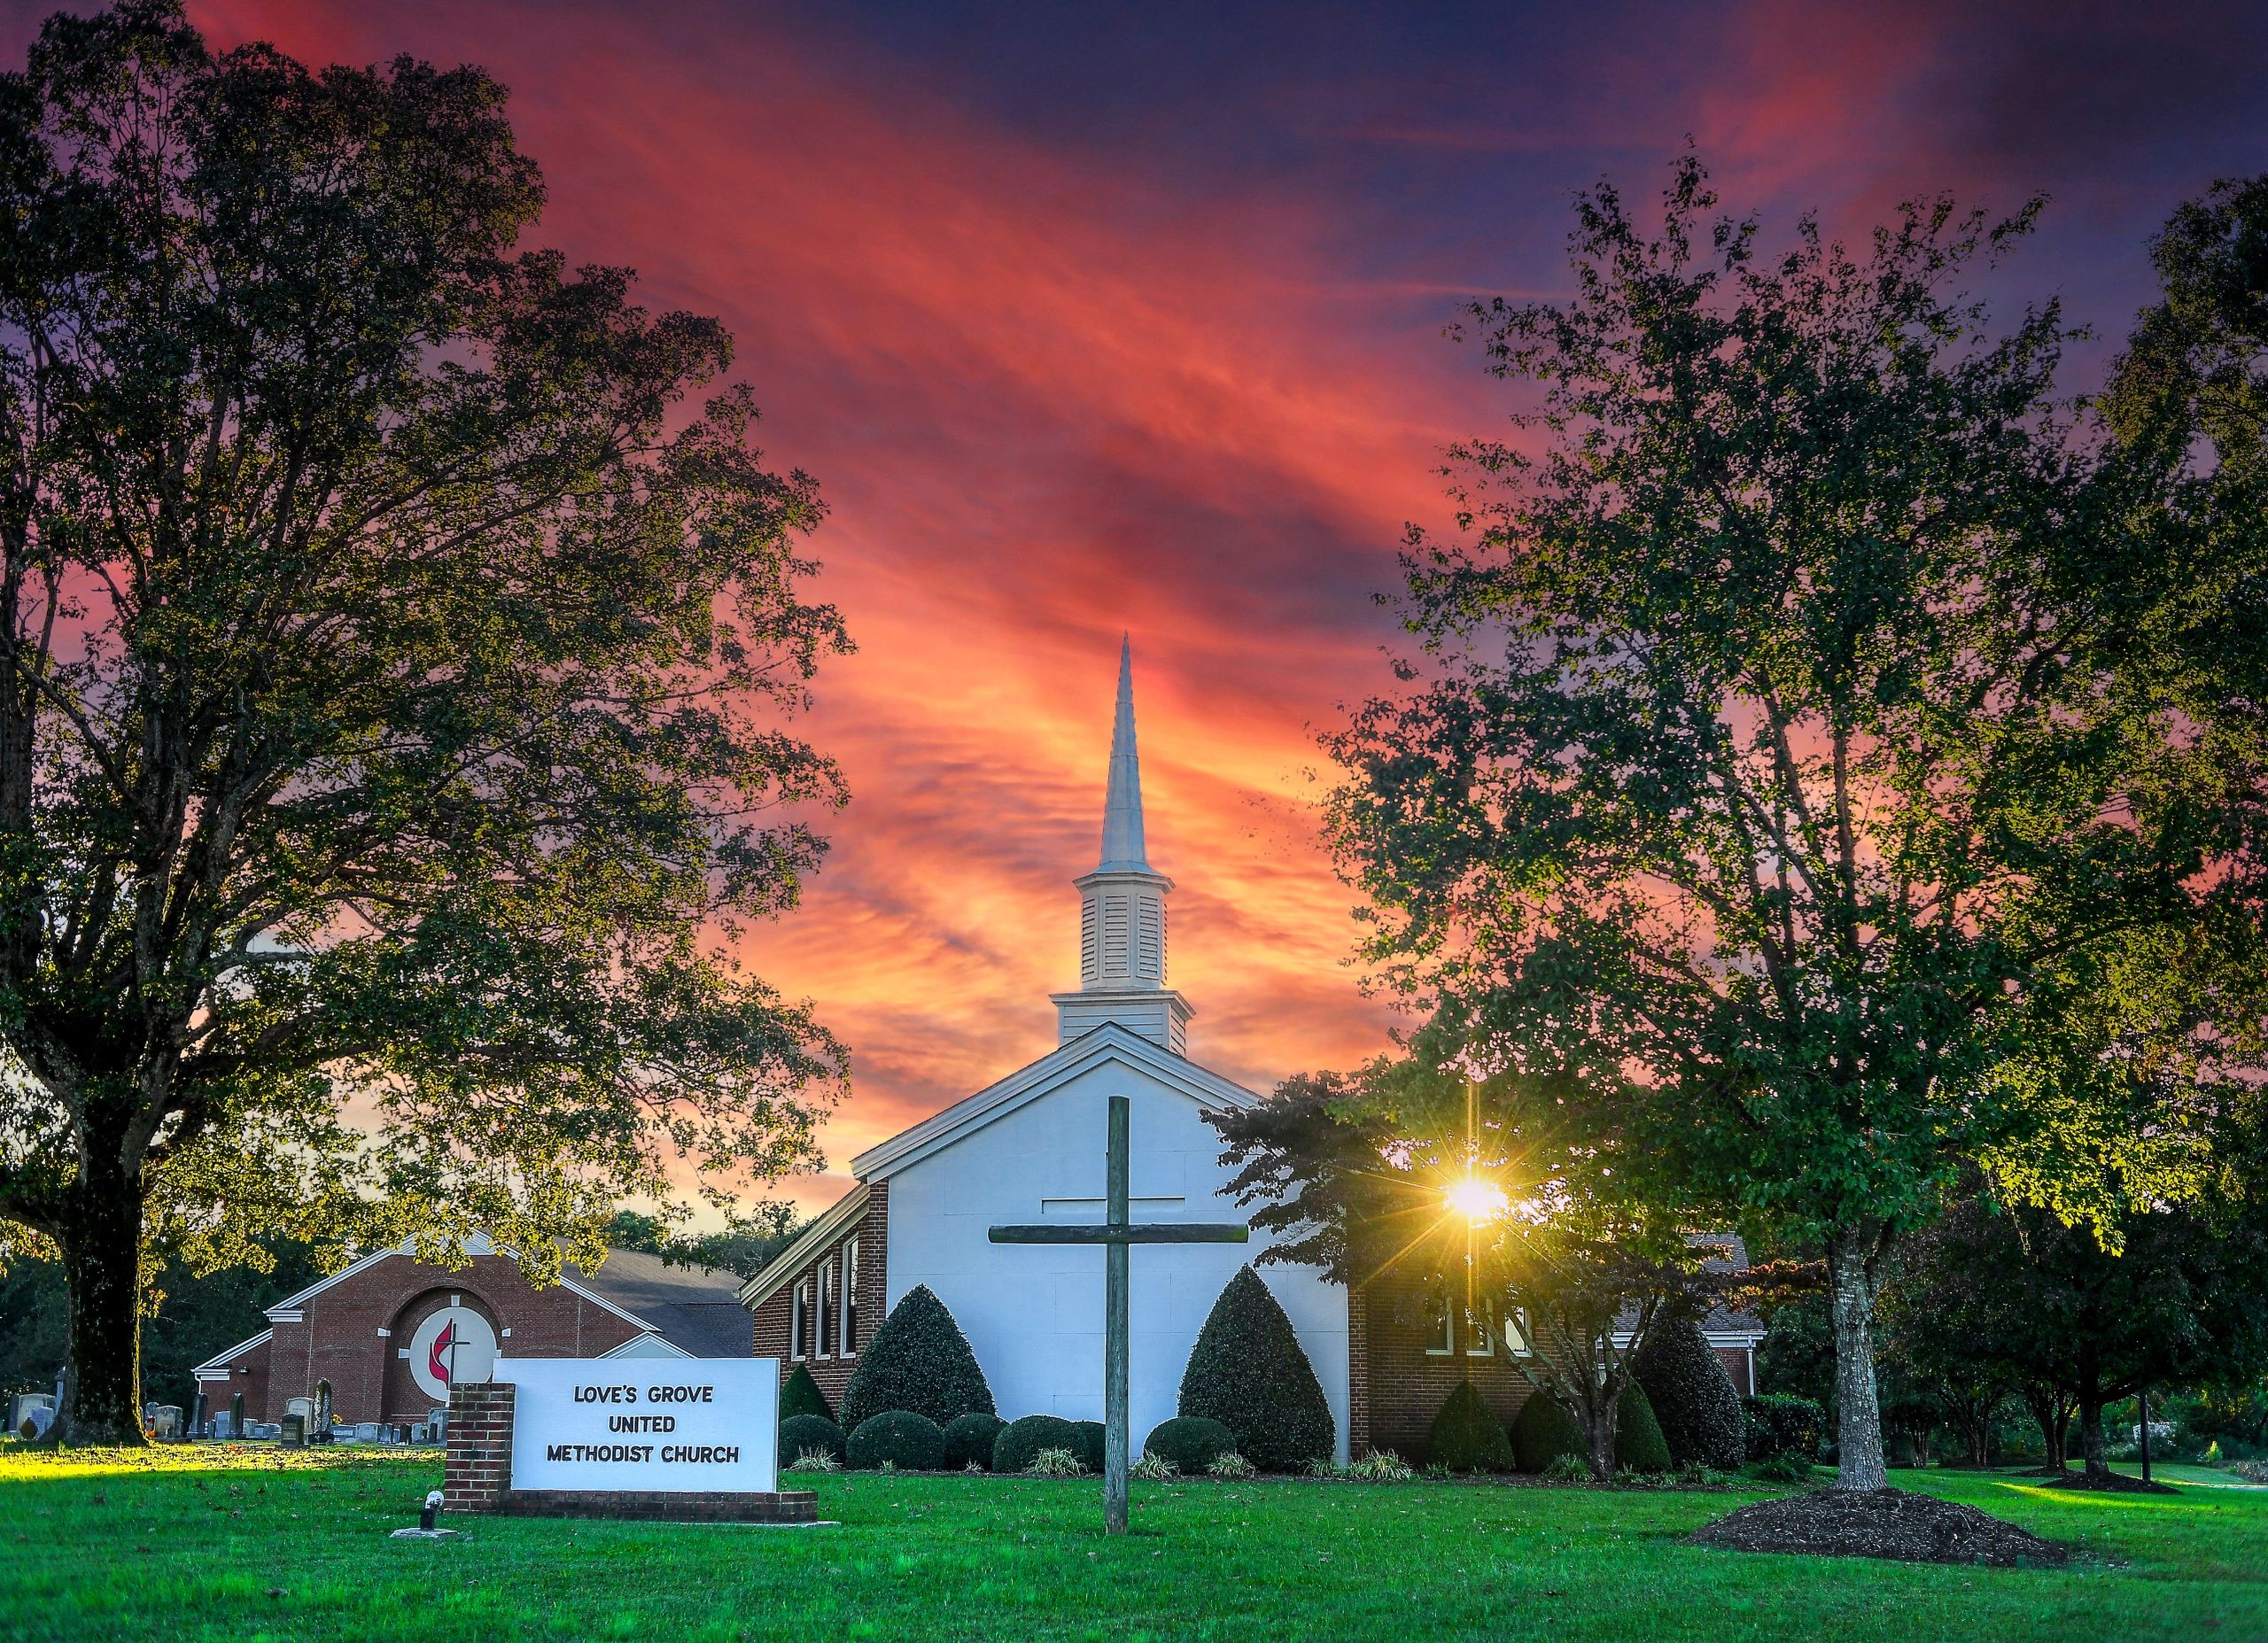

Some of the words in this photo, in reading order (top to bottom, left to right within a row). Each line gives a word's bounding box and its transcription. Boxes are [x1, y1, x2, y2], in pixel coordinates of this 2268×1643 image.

[574, 1384, 637, 1403] LOVE'S
[648, 1385, 714, 1403] GROVE
[609, 1415, 676, 1433] UNITED
[547, 1445, 655, 1463] METHODIST
[661, 1445, 740, 1463] CHURCH
